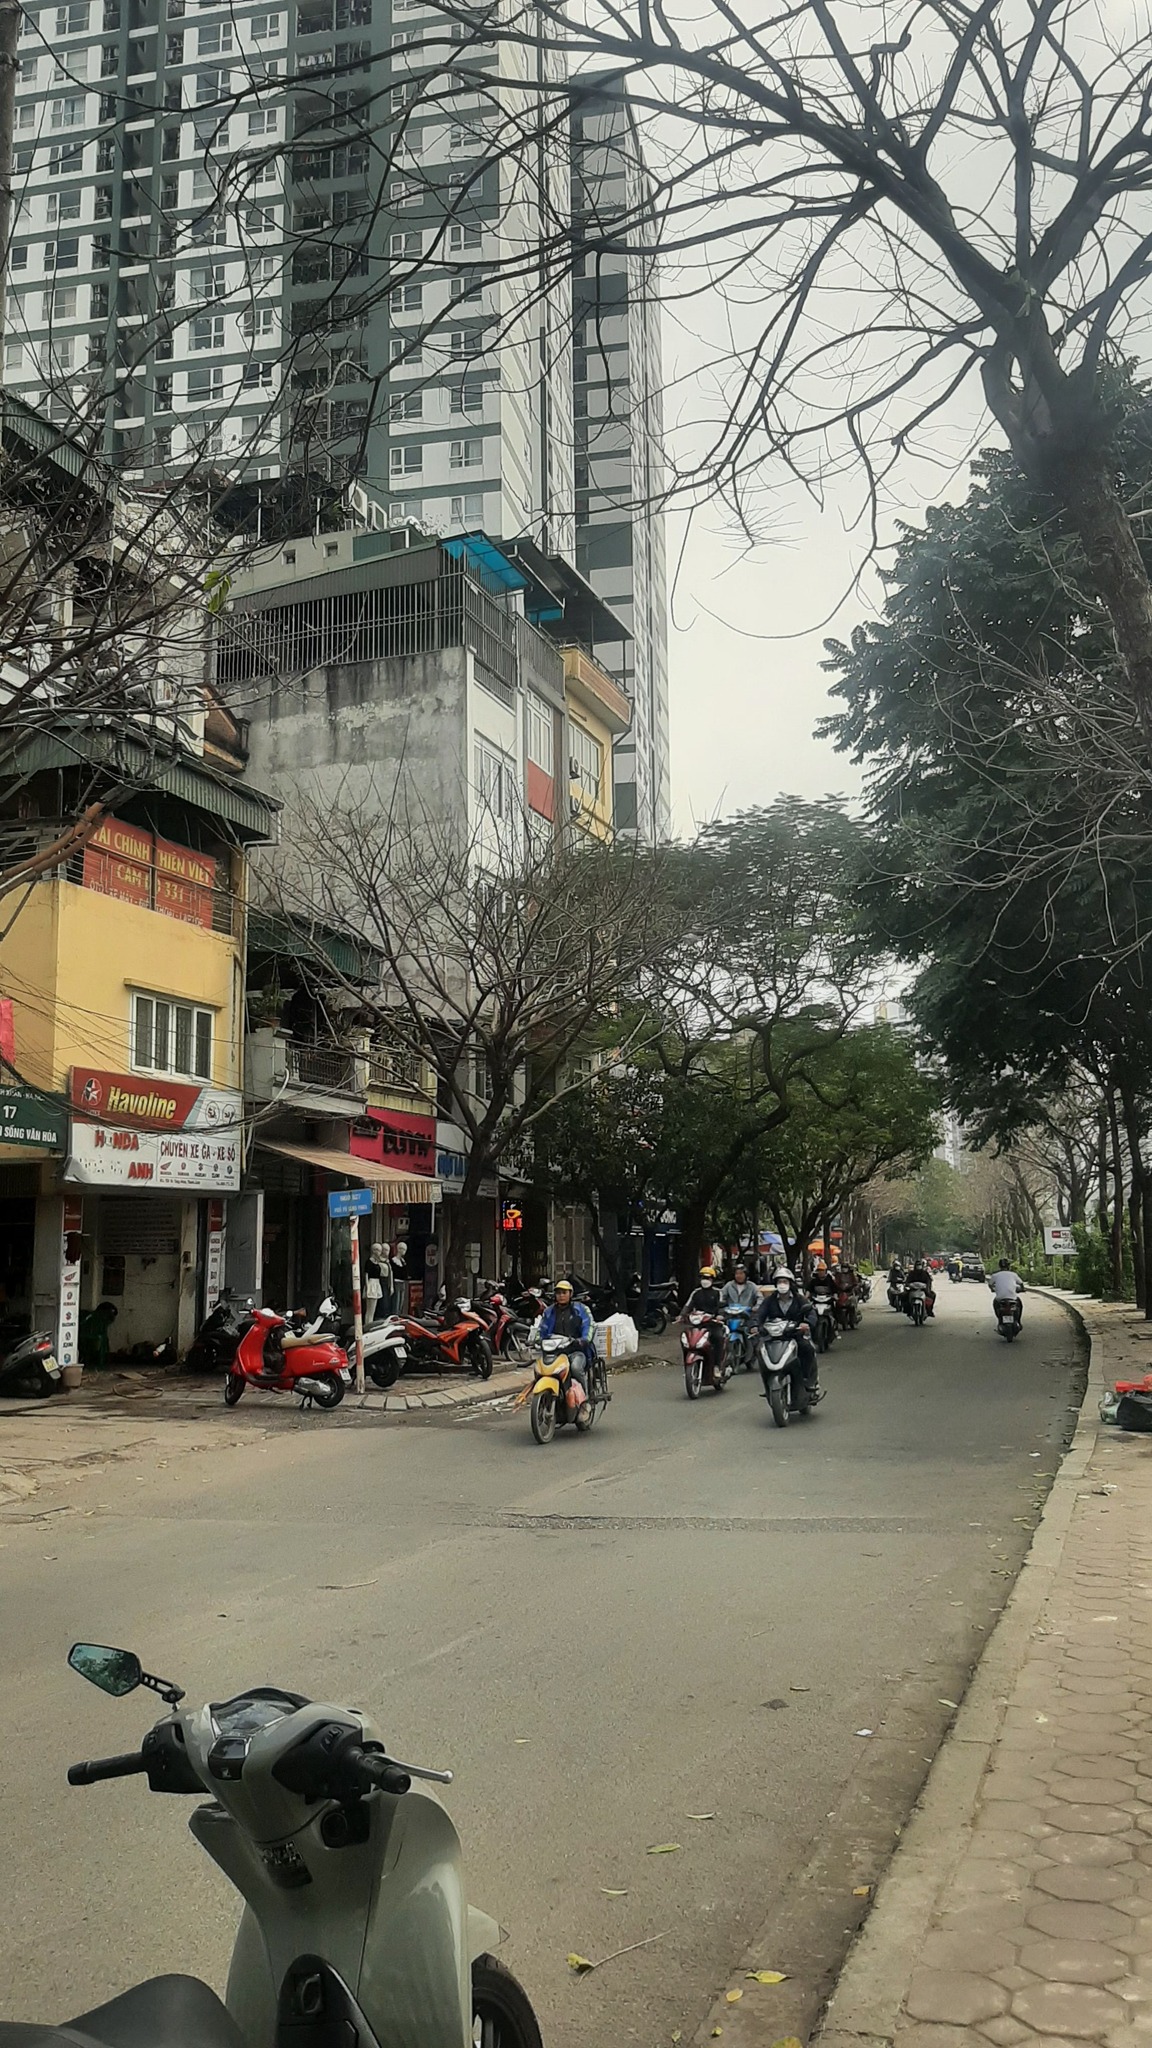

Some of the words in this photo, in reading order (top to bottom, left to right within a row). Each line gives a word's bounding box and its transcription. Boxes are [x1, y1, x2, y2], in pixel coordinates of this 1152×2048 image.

[114, 832, 150, 861] CHÍNH
[3, 1105, 17, 1119] 17
[107, 1086, 177, 1120] Havoline
[4, 1124, 25, 1139] SỐNG
[26, 1128, 41, 1141] VĂN
[41, 1130, 57, 1143] HÓA
[95, 1129, 140, 1151] HNDA
[160, 1139, 188, 1158] CHUYÊN
[190, 1144, 199, 1159] XE
[217, 1146, 226, 1161] XE
[127, 1161, 154, 1180] ANH
